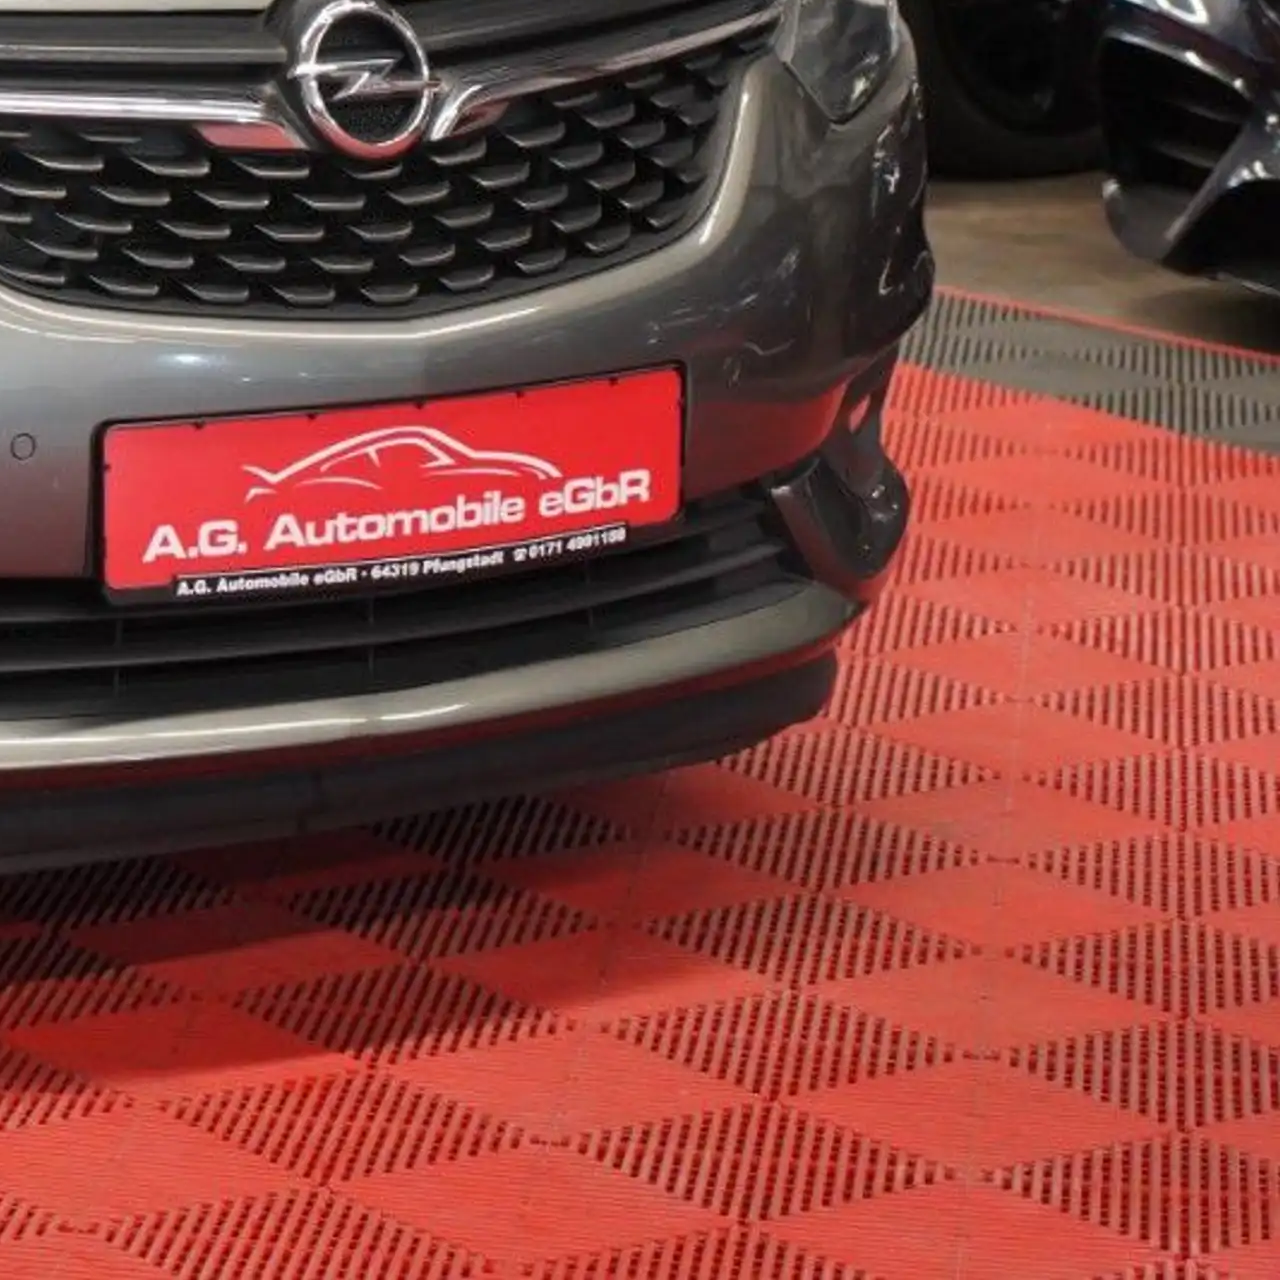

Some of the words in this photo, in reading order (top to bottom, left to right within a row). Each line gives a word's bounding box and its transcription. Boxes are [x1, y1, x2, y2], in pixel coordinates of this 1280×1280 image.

[142, 519, 248, 562] A.G.
[264, 488, 526, 550] Automobile
[538, 468, 650, 518] eGbR
[176, 579, 211, 596] A.G.
[216, 572, 309, 593] Automobile
[313, 567, 357, 585] eGbR
[370, 561, 420, 580] 64319
[422, 550, 504, 574] Pfungstadt
